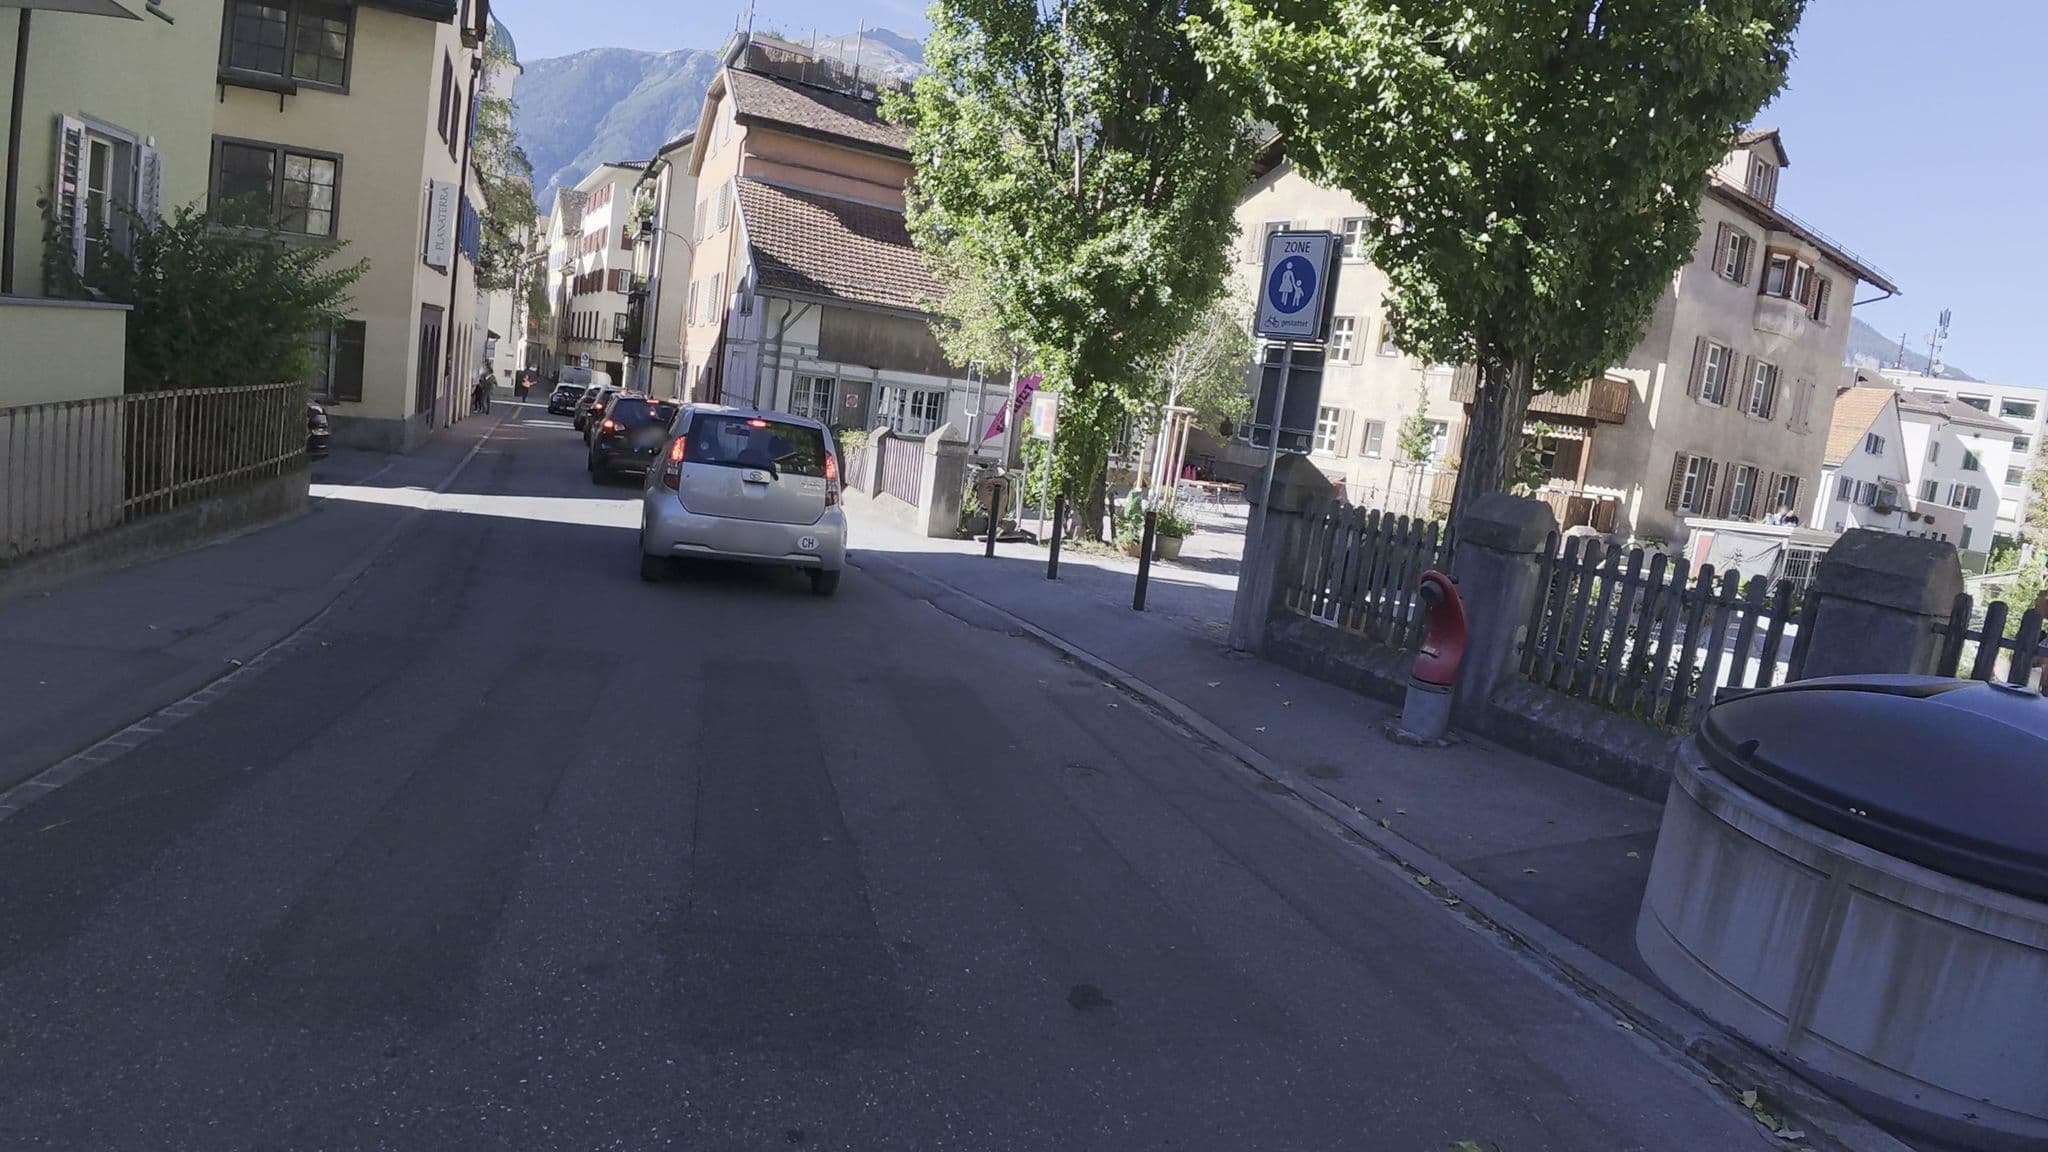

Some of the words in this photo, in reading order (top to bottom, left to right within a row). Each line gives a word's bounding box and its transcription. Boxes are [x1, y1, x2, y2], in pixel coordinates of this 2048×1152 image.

[435, 186, 449, 251] PLANATERRA
[1284, 241, 1311, 253] ZONE
[801, 537, 815, 549] CH
